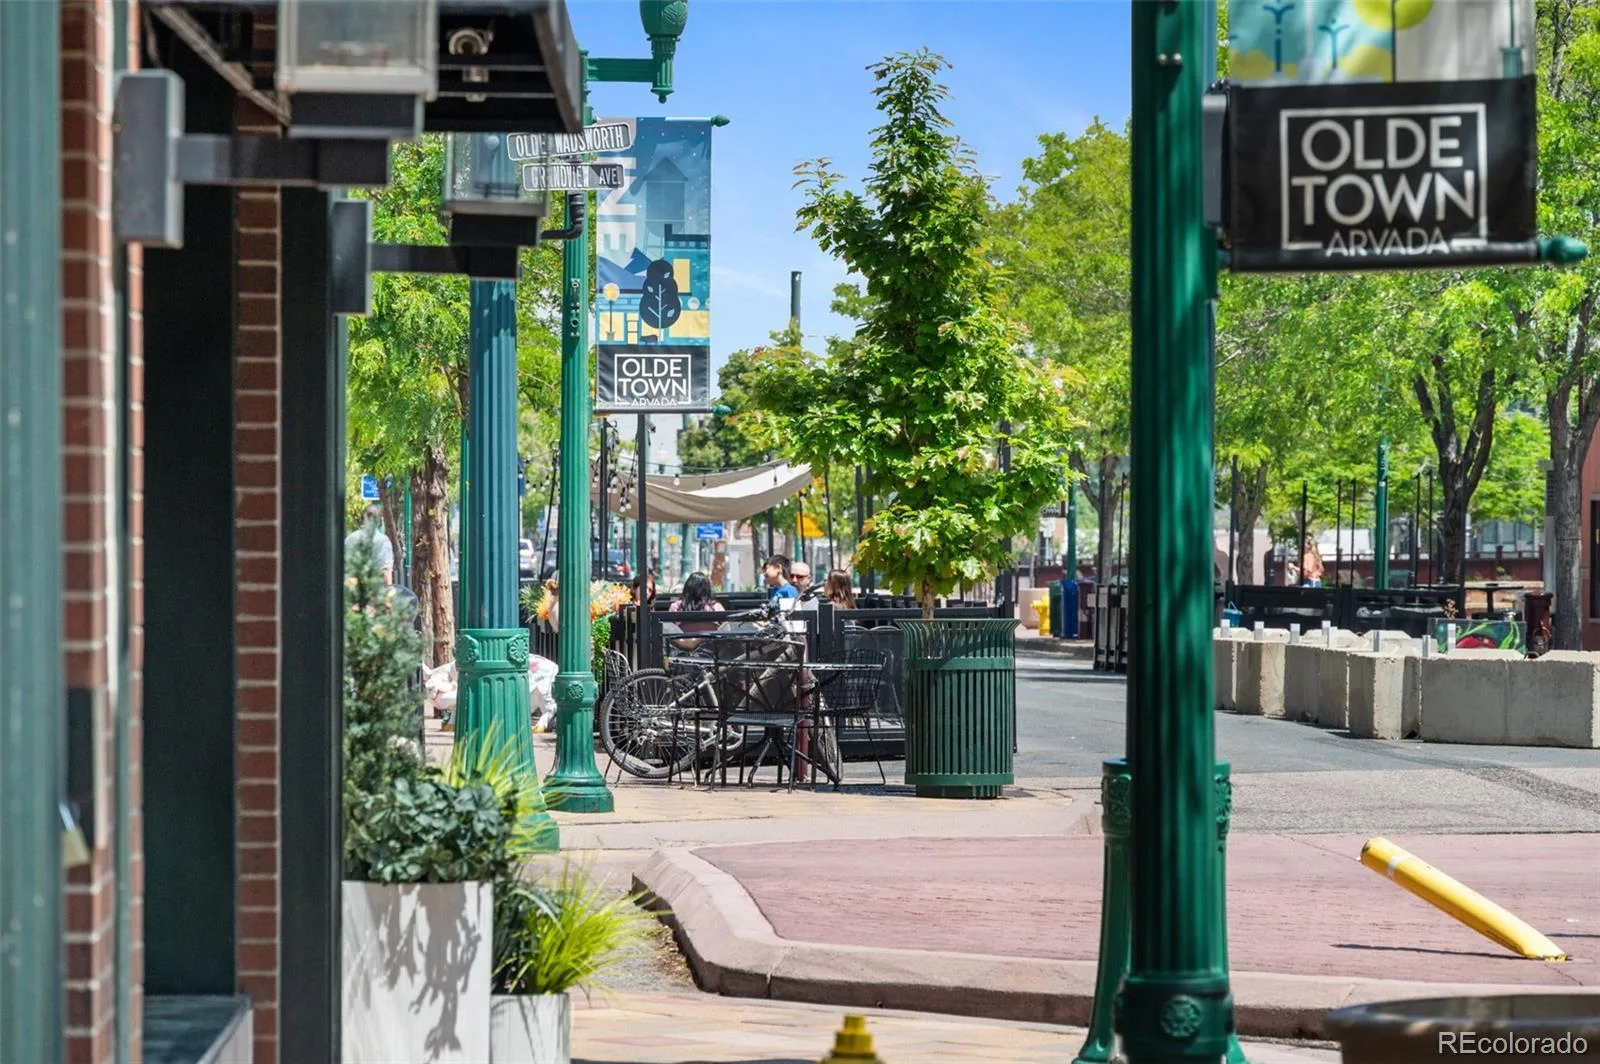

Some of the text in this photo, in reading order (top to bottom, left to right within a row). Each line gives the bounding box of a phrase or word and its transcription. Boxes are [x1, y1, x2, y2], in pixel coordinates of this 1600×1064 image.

[554, 126, 624, 153] WADSWORTH
[1301, 116, 1464, 171] OLDE
[531, 166, 589, 188] GRNDVIEW
[1291, 170, 1475, 225] TOWN
[1326, 227, 1450, 257] ARVADA
[622, 358, 683, 377] OLDE
[618, 378, 687, 397] TOWN
[631, 398, 678, 407] ARVADA
